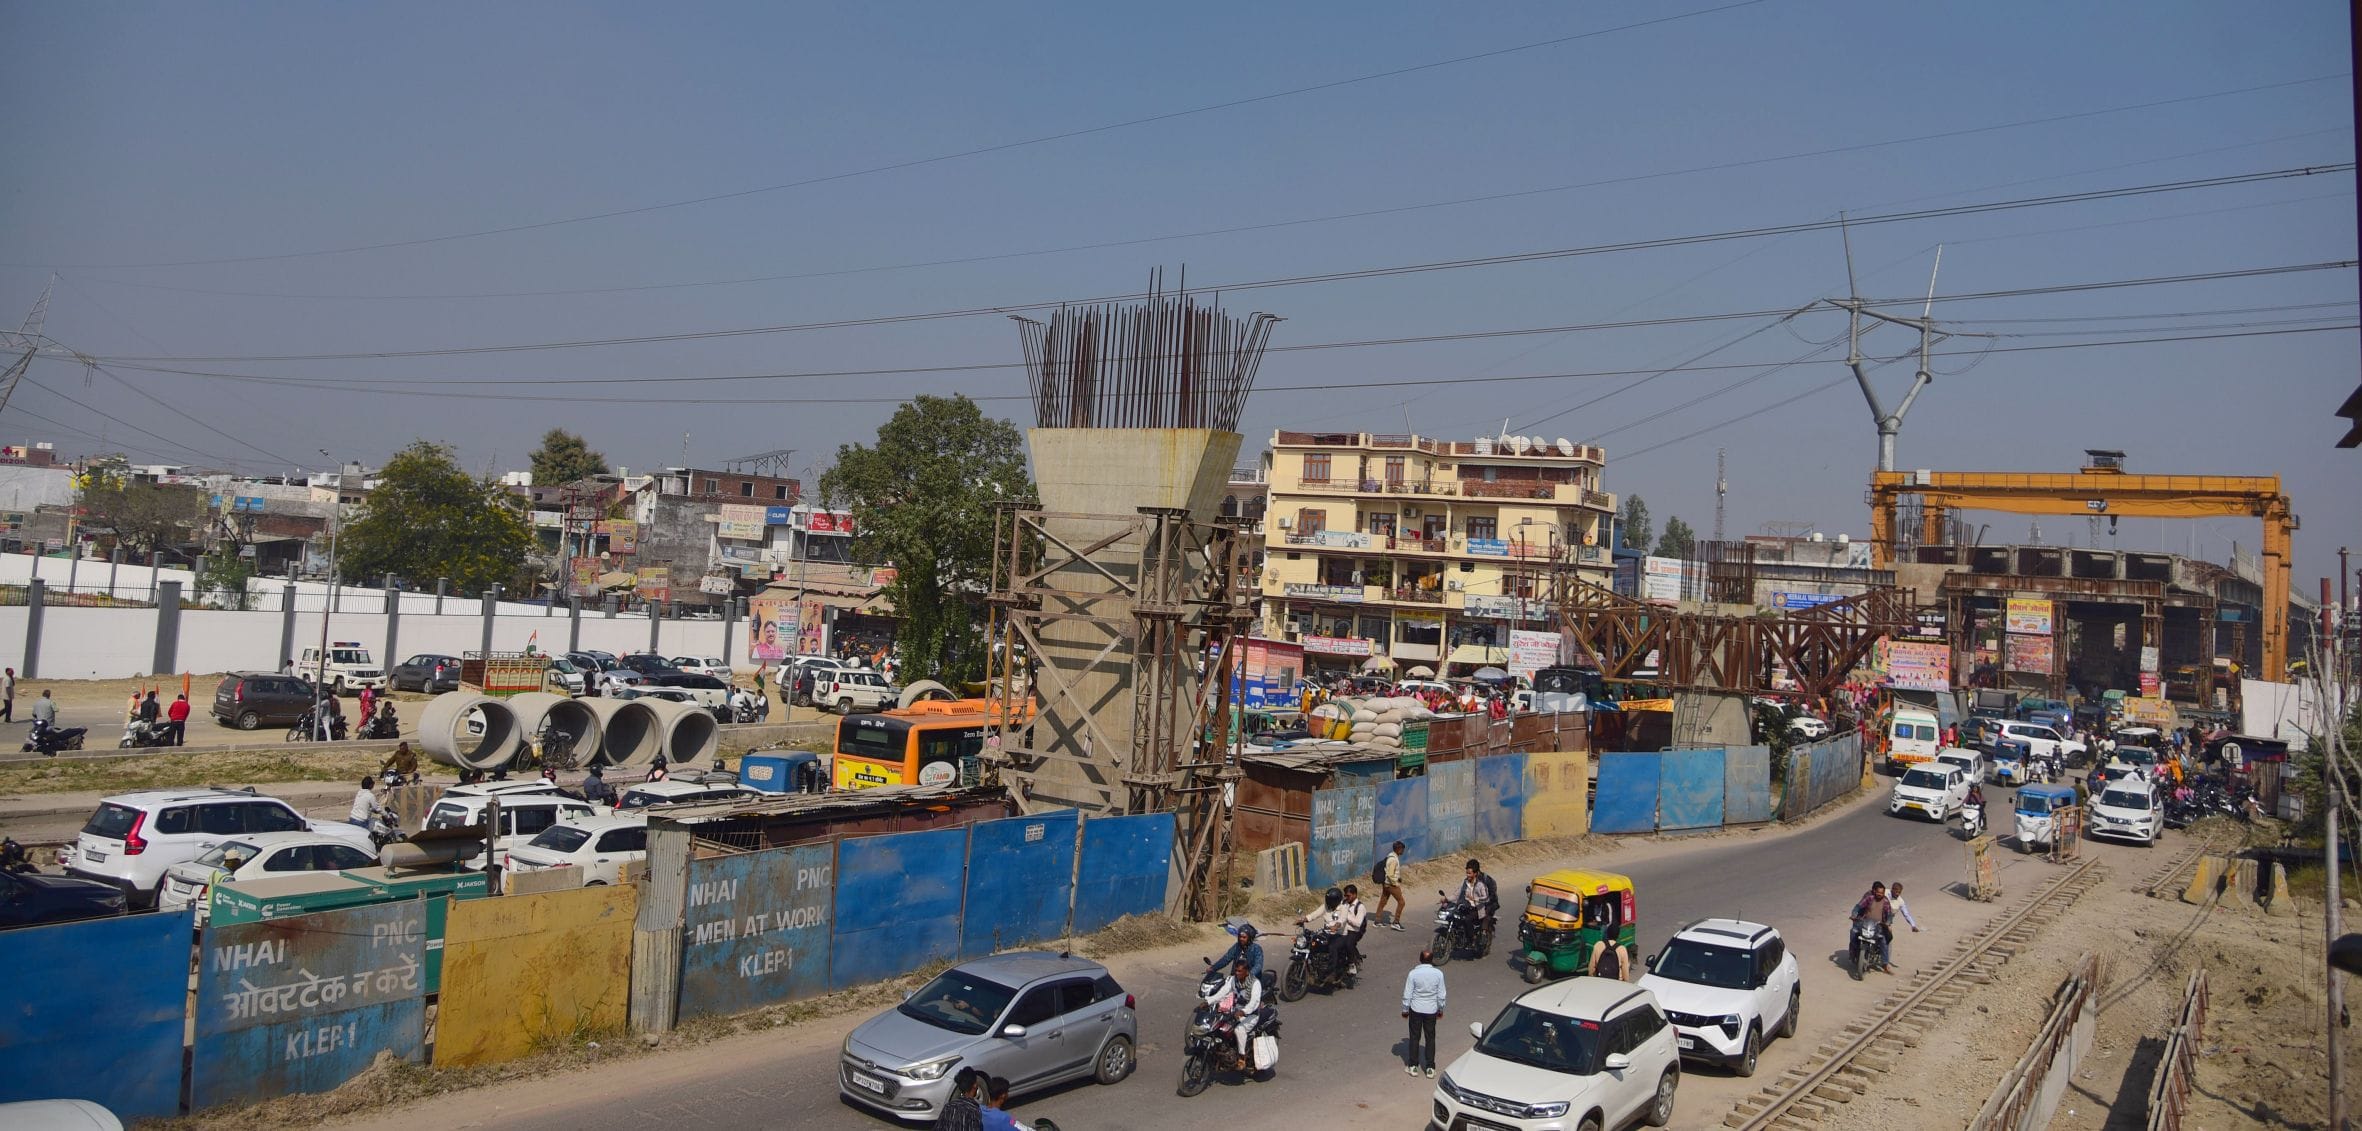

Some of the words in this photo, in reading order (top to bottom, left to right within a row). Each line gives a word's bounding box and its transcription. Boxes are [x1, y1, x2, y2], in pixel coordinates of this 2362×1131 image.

[1315, 799, 1335, 815] NHAI
[1357, 796, 1373, 811] PNC
[463, 879, 486, 888] JAKSON
[690, 878, 738, 907] NHAI
[797, 866, 831, 891] PNC
[213, 938, 285, 972] NHAI
[373, 919, 418, 949] PNC
[695, 918, 736, 946] MEN
[743, 912, 768, 939] AT
[776, 905, 828, 932] WORK
[223, 967, 347, 1021] ओवरटेक
[352, 971, 373, 998] न
[376, 953, 420, 993] करें
